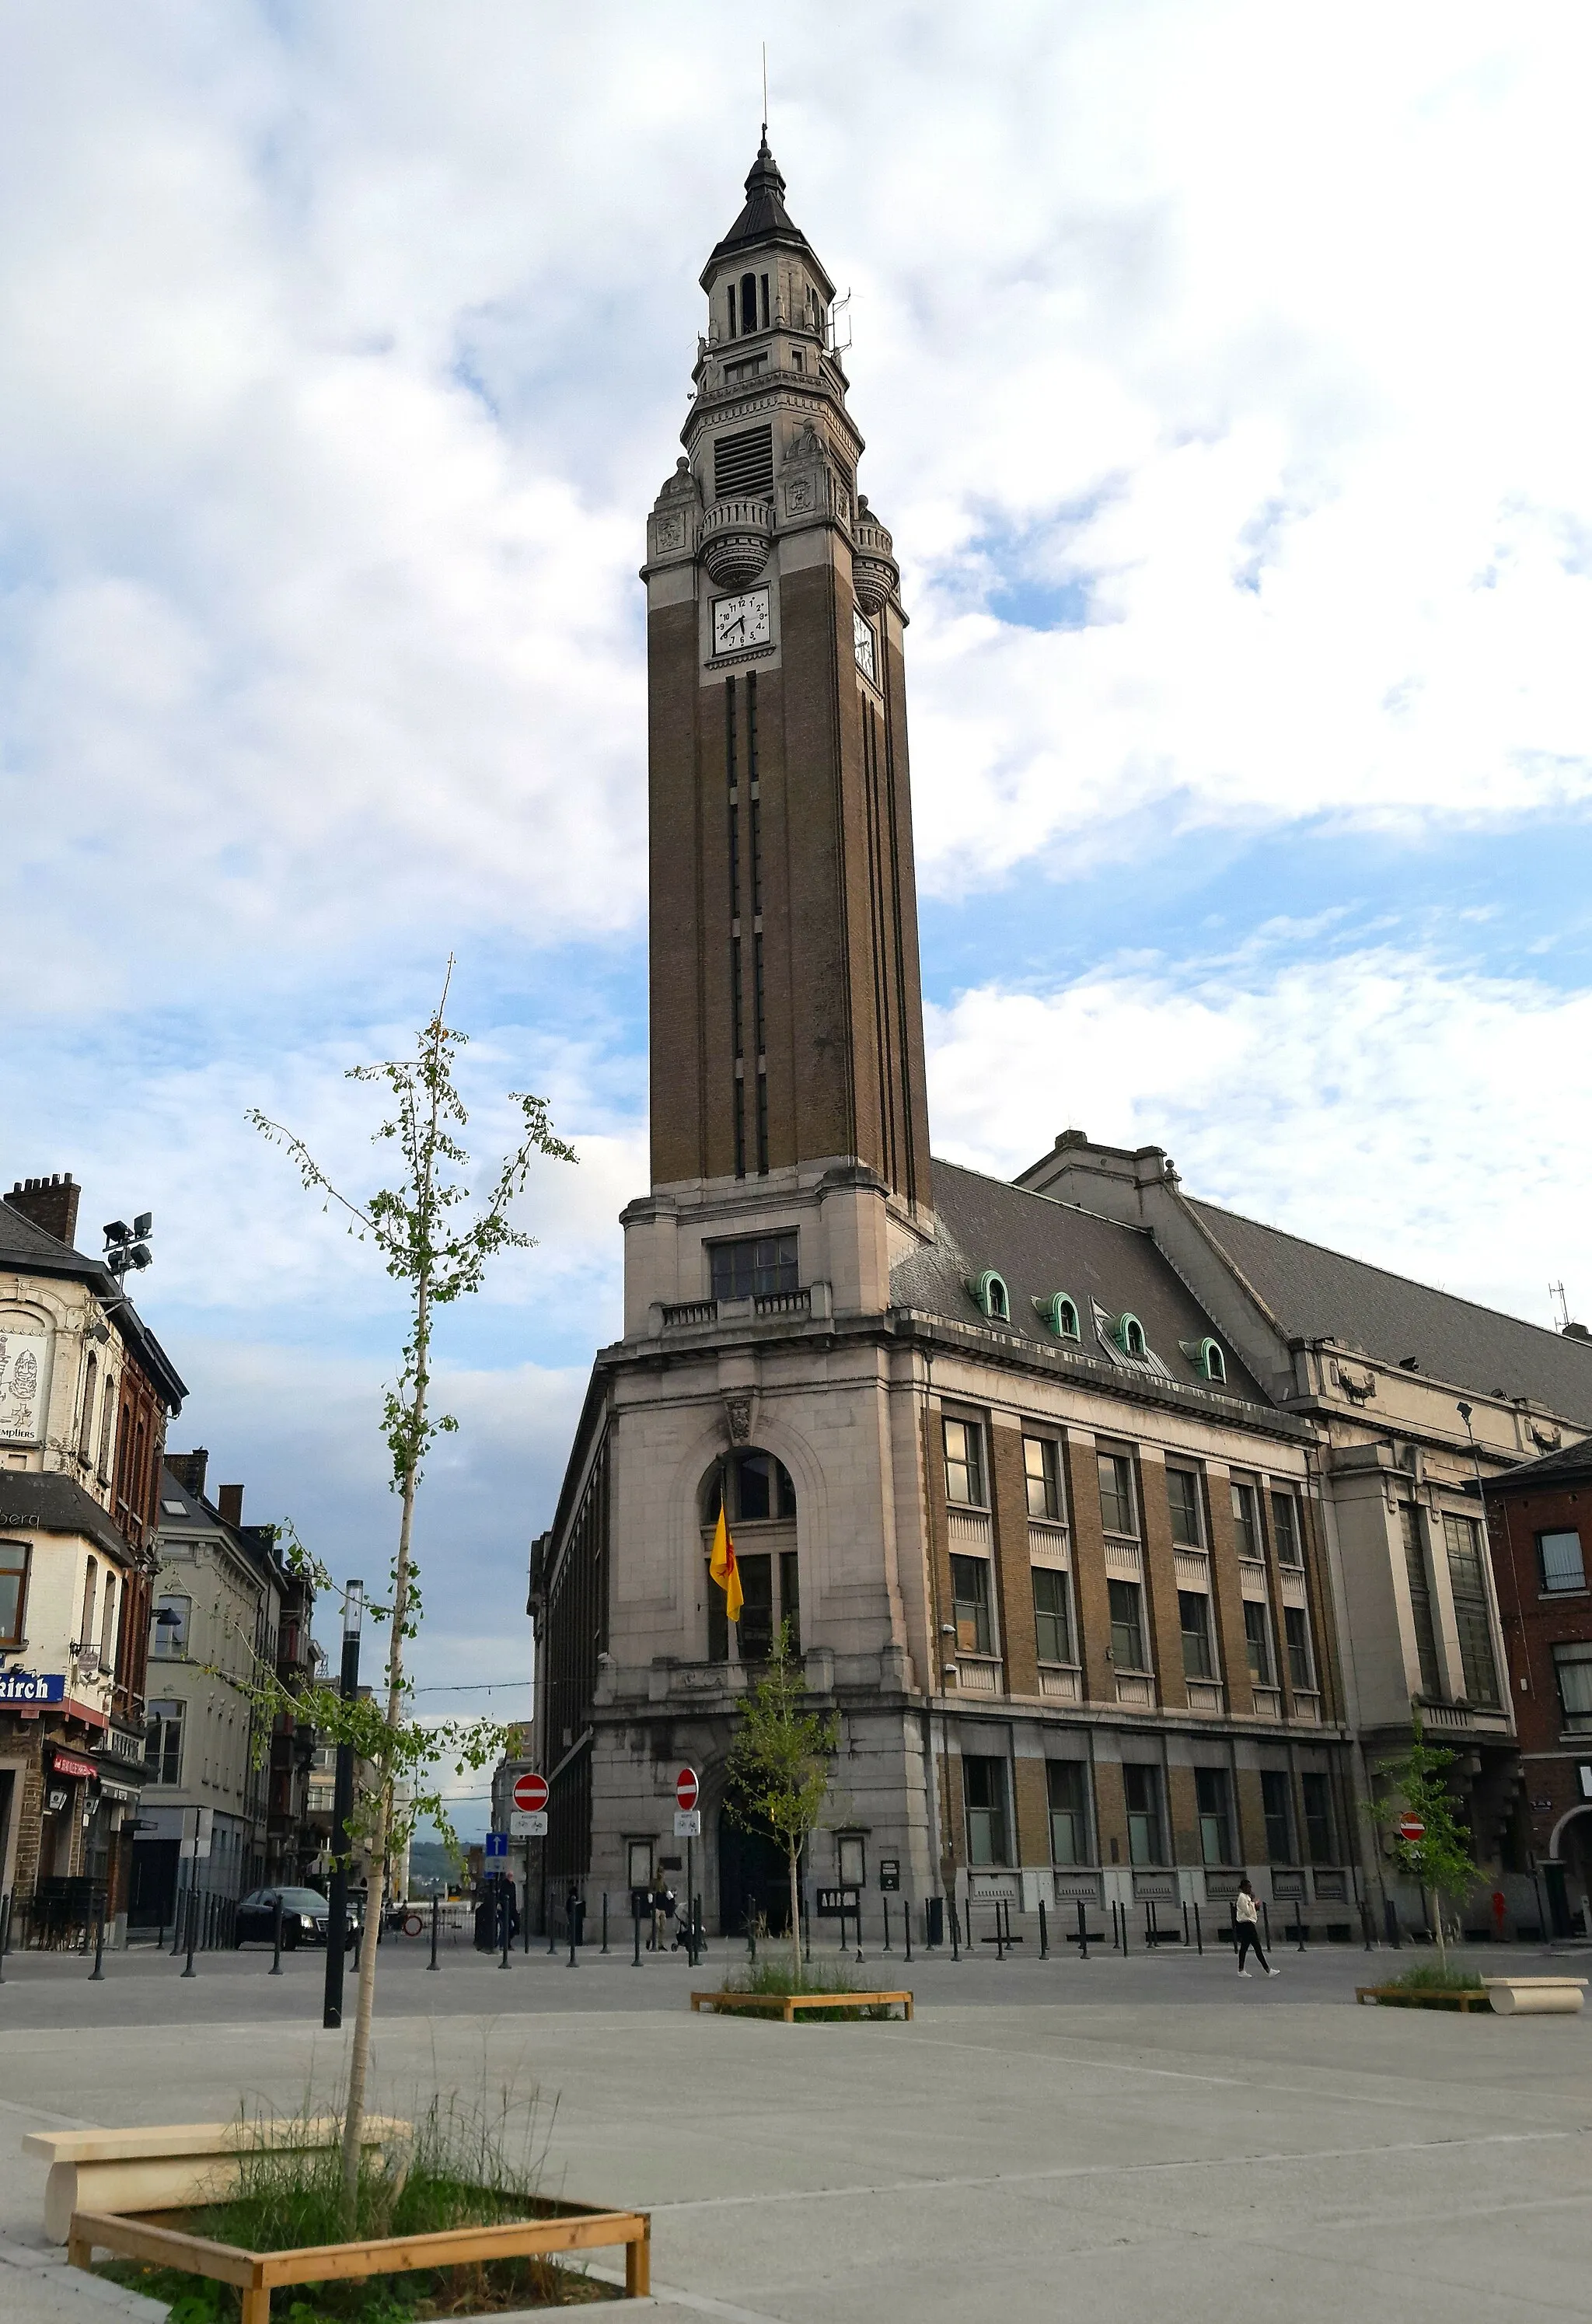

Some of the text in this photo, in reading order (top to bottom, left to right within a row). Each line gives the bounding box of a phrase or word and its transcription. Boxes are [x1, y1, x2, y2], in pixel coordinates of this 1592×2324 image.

[729, 604, 736, 613] 11
[723, 613, 730, 621] 10
[749, 631, 754, 639] 5
